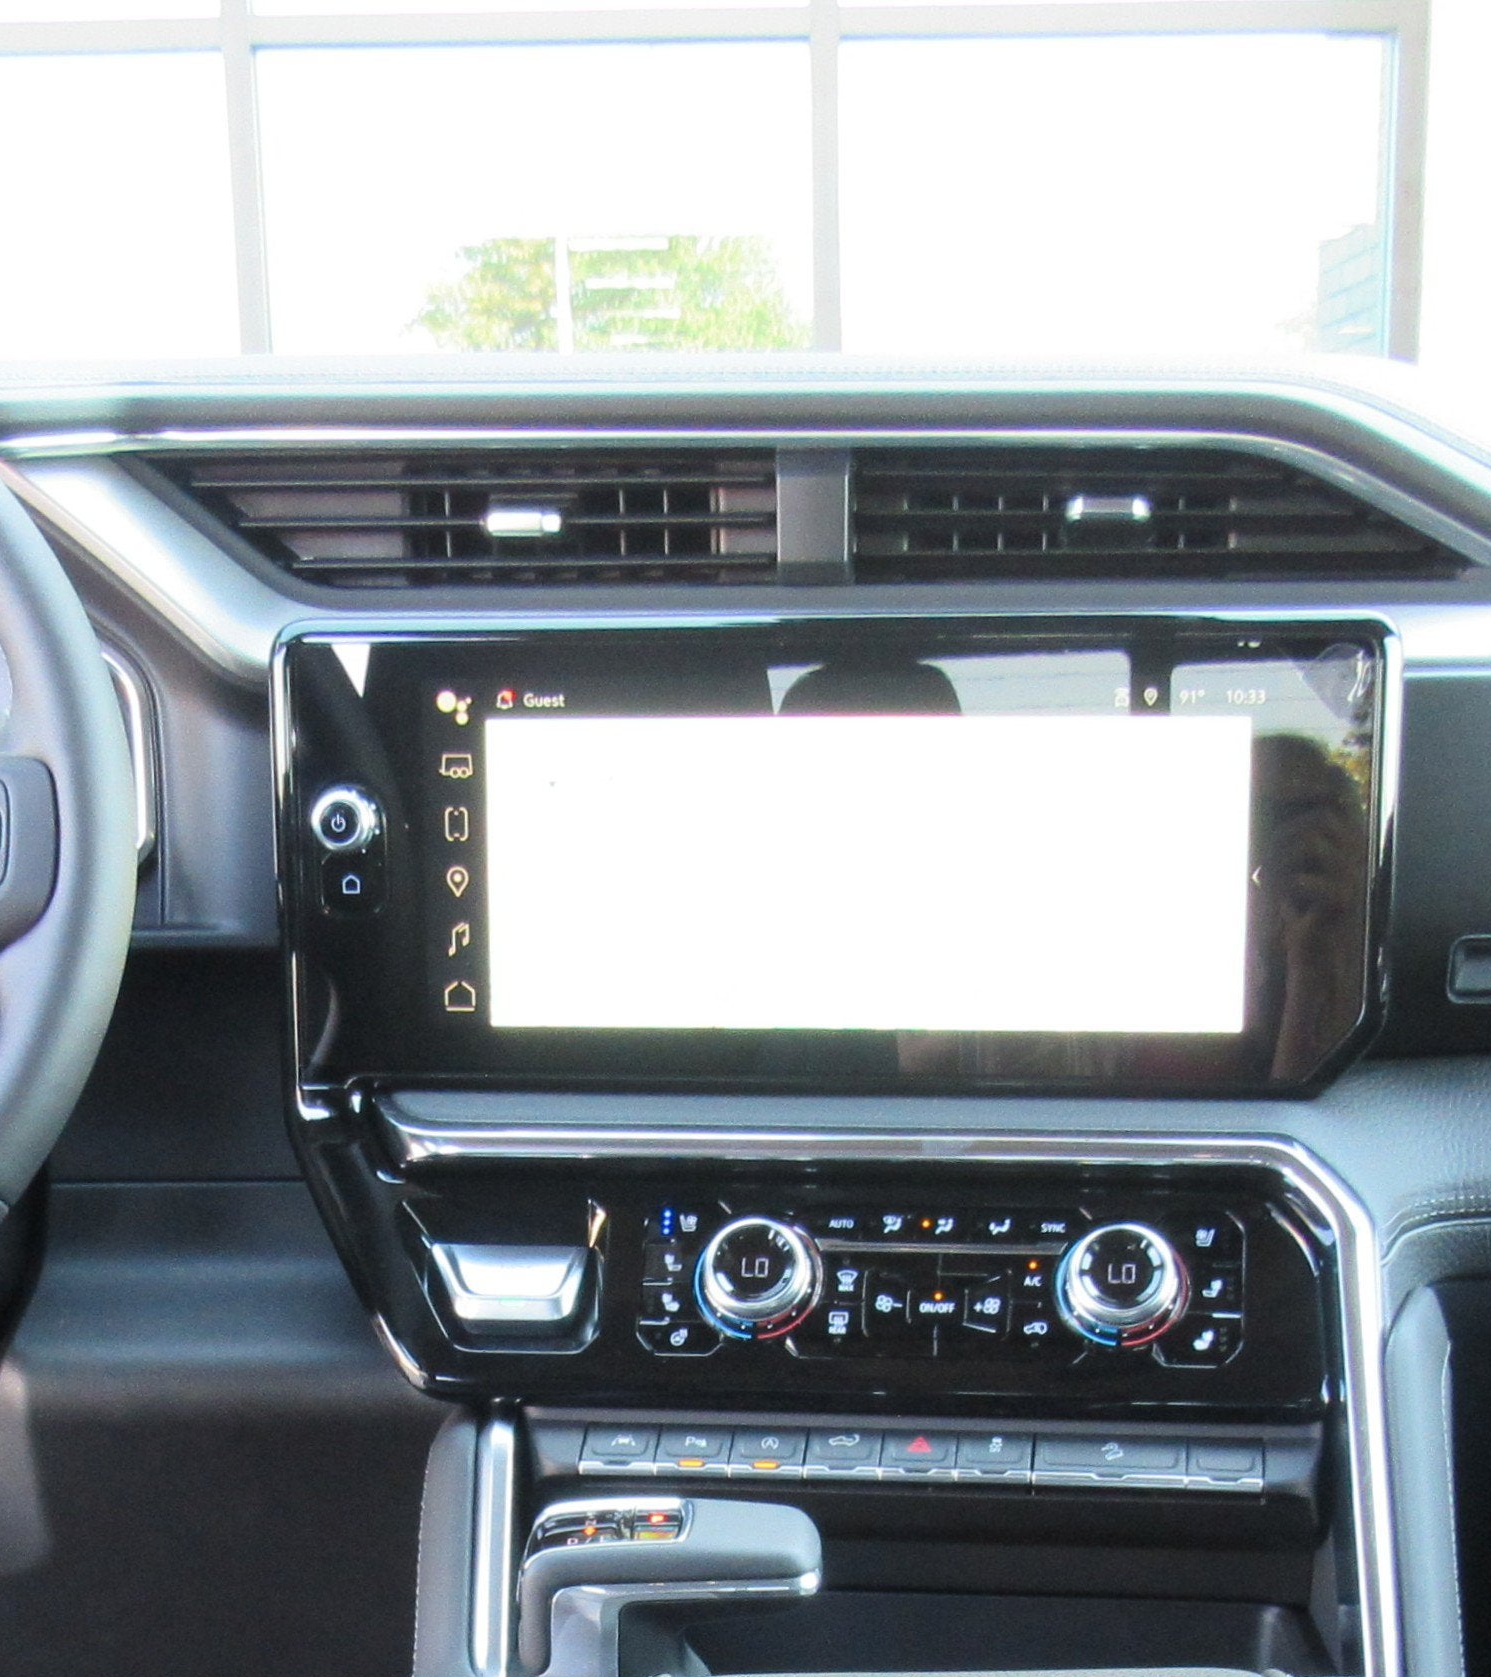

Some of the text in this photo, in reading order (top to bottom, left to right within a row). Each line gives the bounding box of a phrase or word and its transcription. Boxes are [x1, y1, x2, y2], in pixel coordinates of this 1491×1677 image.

[523, 692, 566, 708] Guest
[1226, 689, 1266, 705] 10:33
[828, 1218, 855, 1230] AUTO
[1040, 1222, 1066, 1234] SYNC
[741, 1257, 769, 1278] LO
[1108, 1263, 1136, 1284] LO
[1023, 1275, 1043, 1287] A/C
[837, 1283, 855, 1292] MAX
[918, 1302, 956, 1314] ON/OFF
[828, 1325, 847, 1335] REAR
